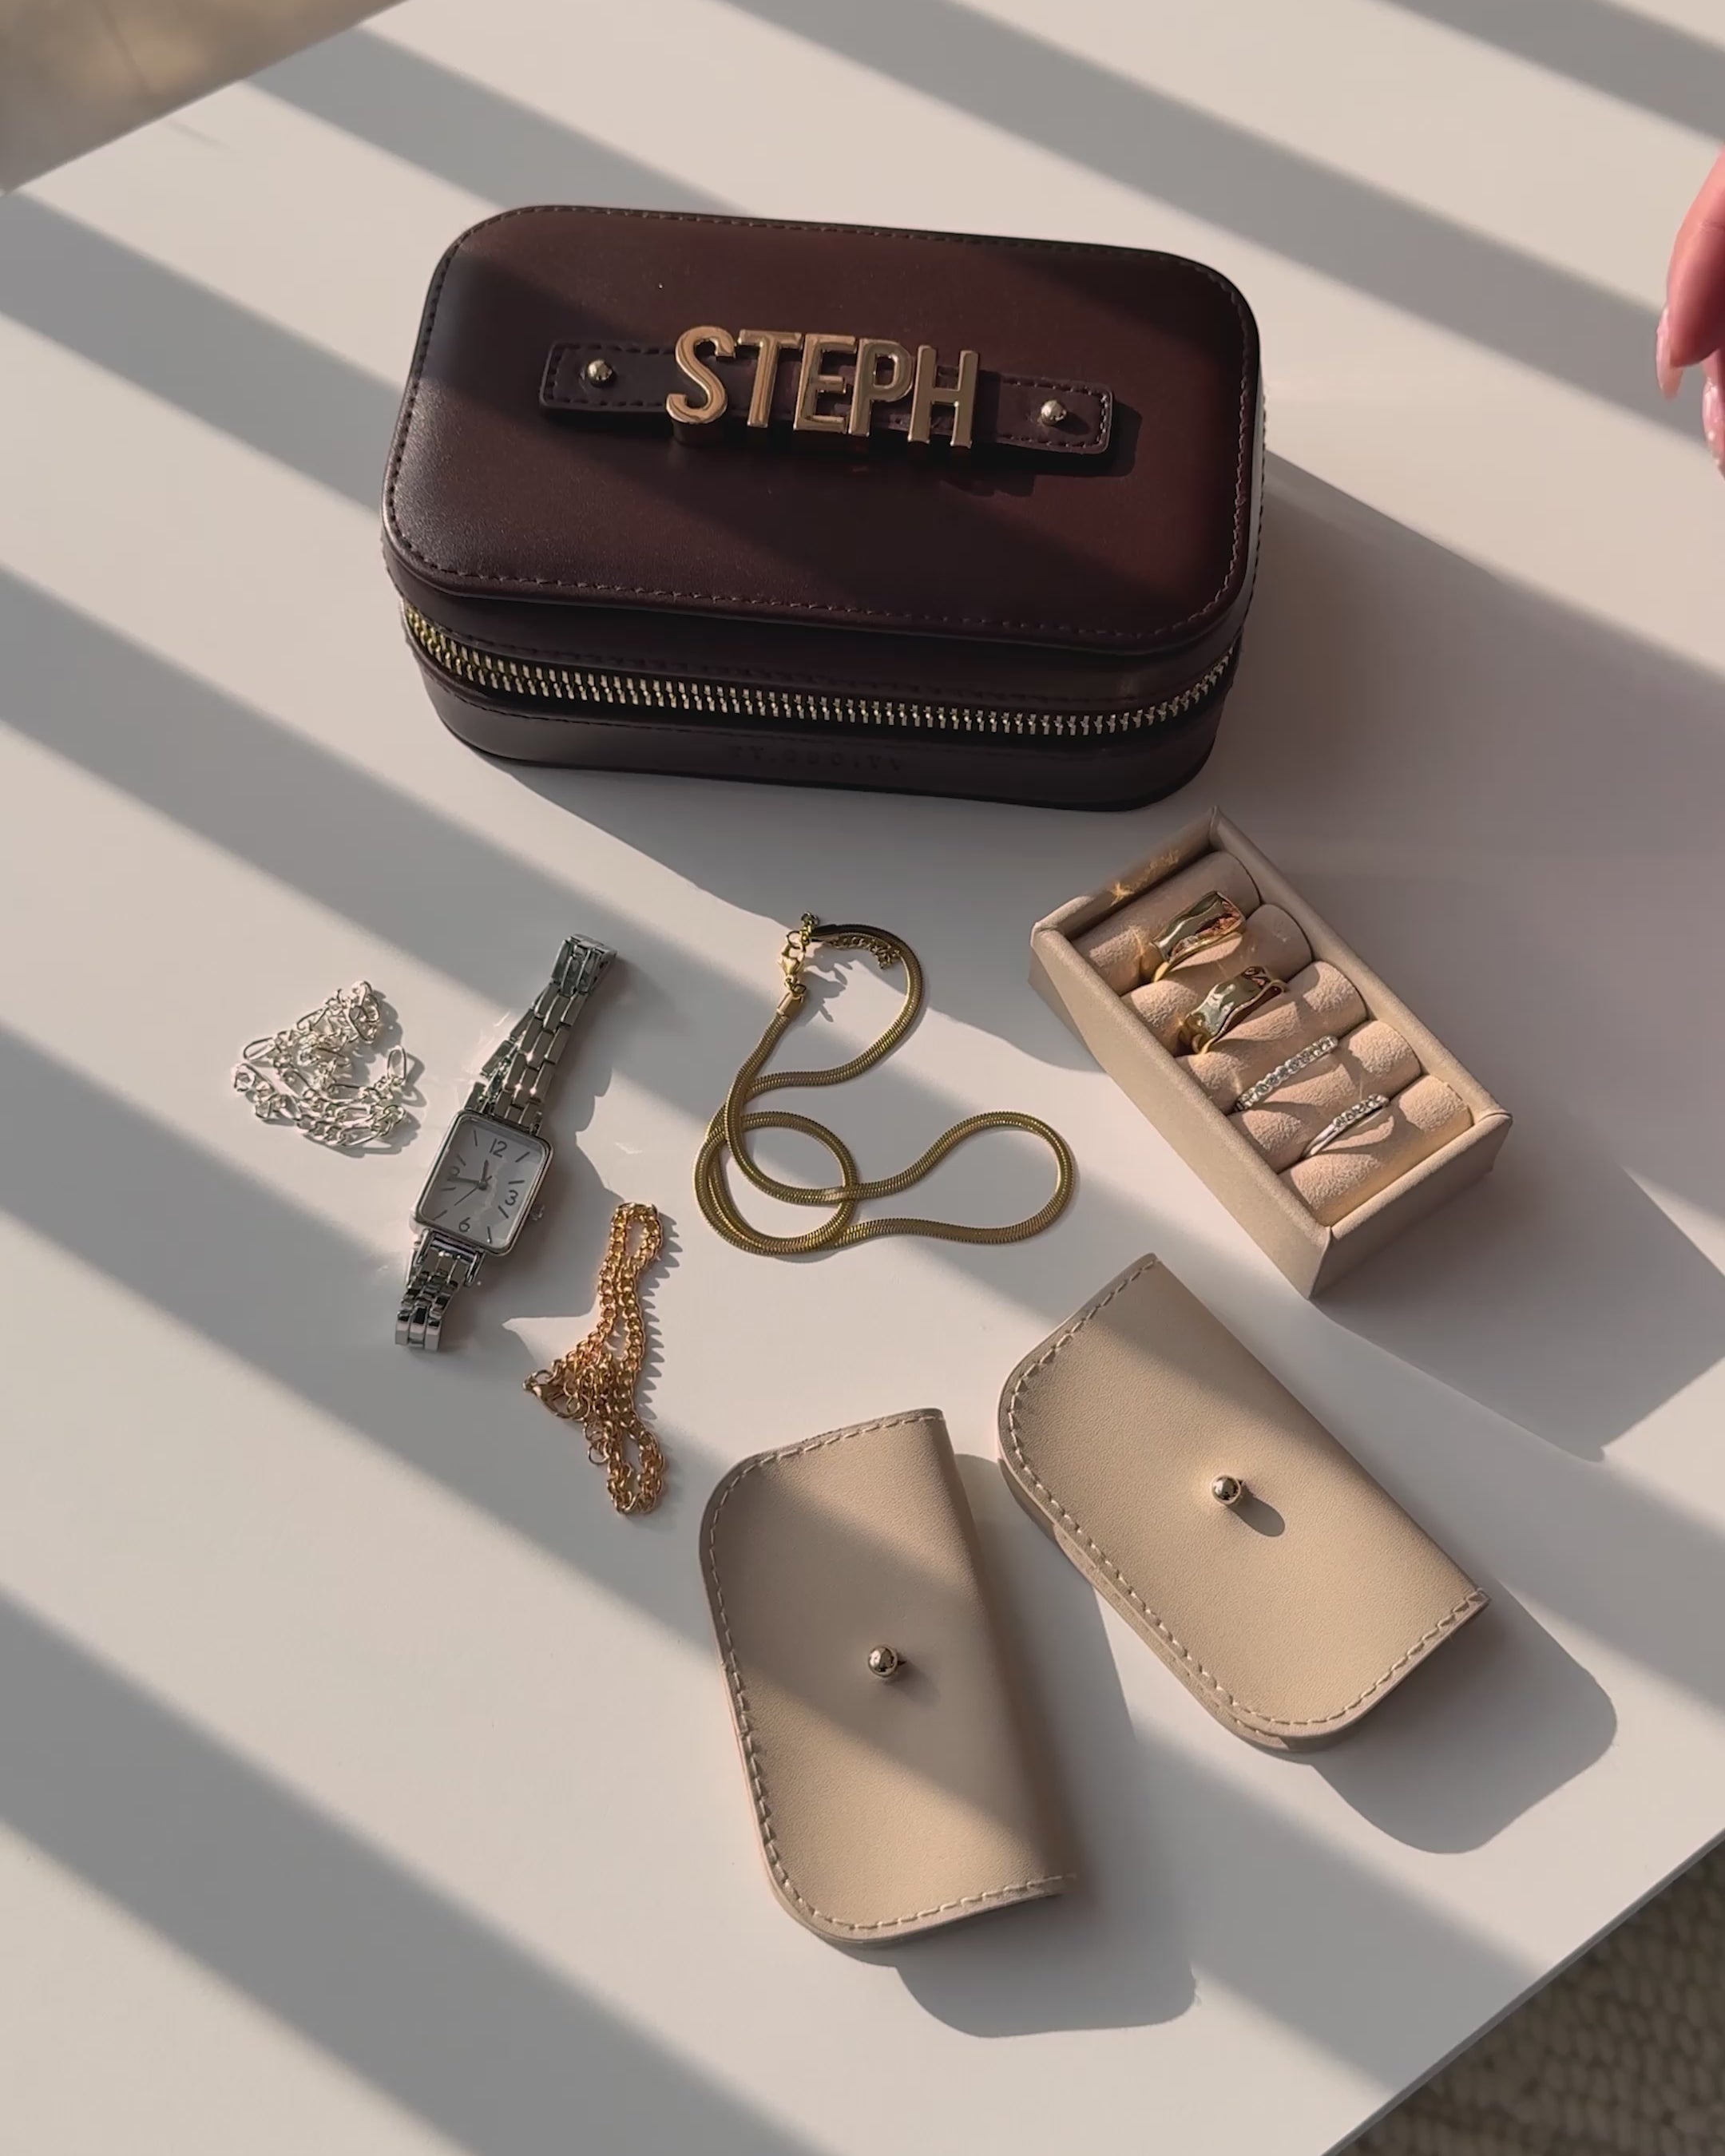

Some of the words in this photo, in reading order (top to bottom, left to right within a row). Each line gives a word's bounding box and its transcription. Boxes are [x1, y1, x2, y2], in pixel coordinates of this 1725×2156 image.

[666, 326, 979, 448] STEPH
[490, 1139, 508, 1158] 12
[505, 1190, 518, 1206] 3
[458, 1217, 471, 1233] 6
